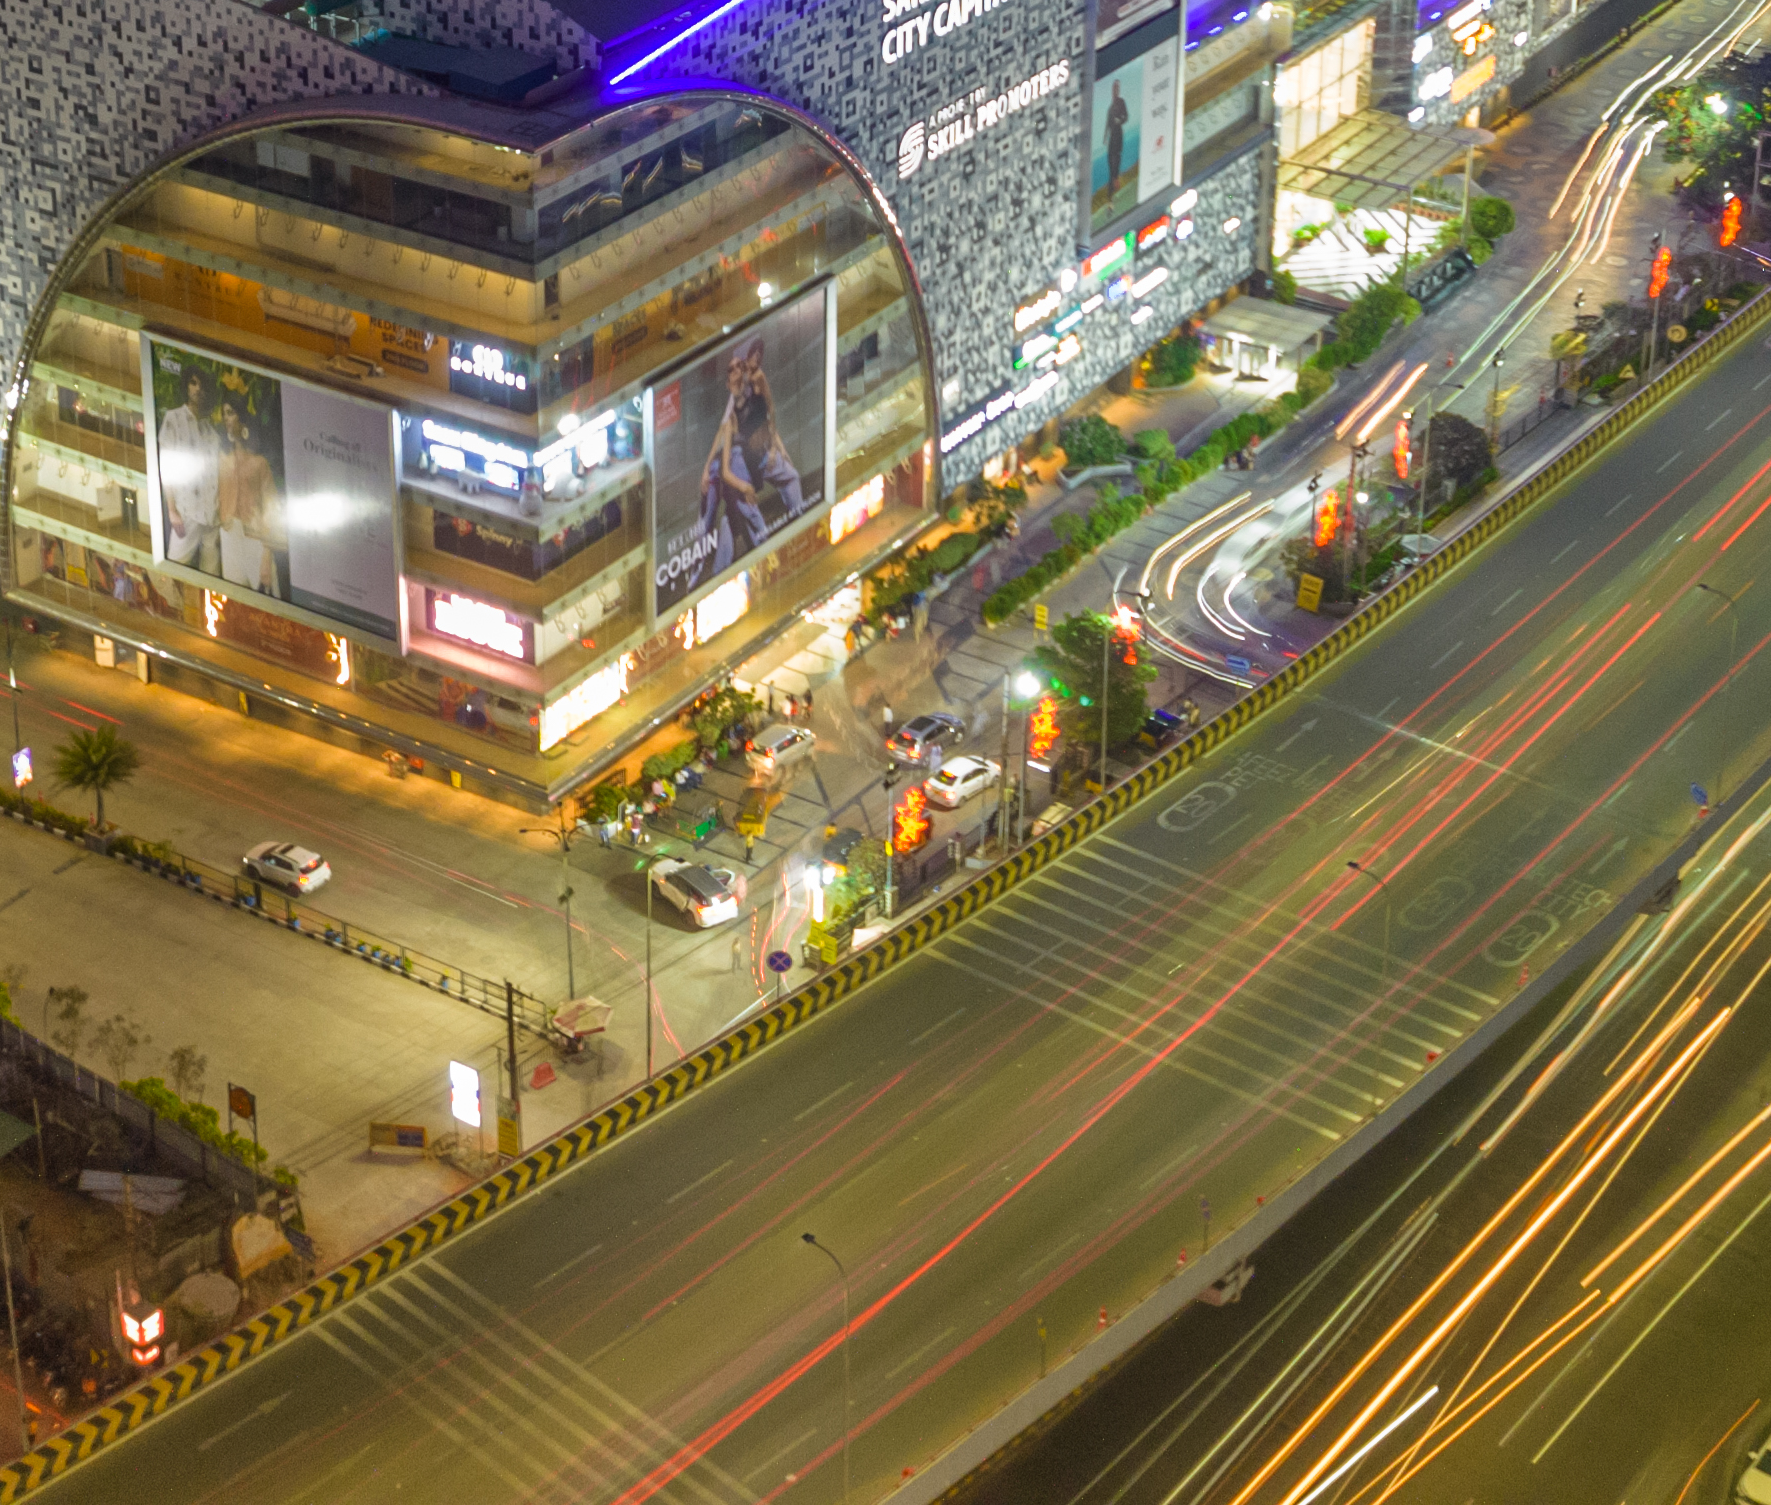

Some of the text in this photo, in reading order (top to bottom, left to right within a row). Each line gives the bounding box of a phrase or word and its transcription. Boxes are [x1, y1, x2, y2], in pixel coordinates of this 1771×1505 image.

[882, 11, 931, 64] CITY
[927, 59, 1070, 161] SKILL PROMOTERS
[929, 114, 937, 128] A
[937, 92, 974, 125] PROJET
[655, 528, 719, 587] COBAIN
[1176, 795, 1216, 819] 20
